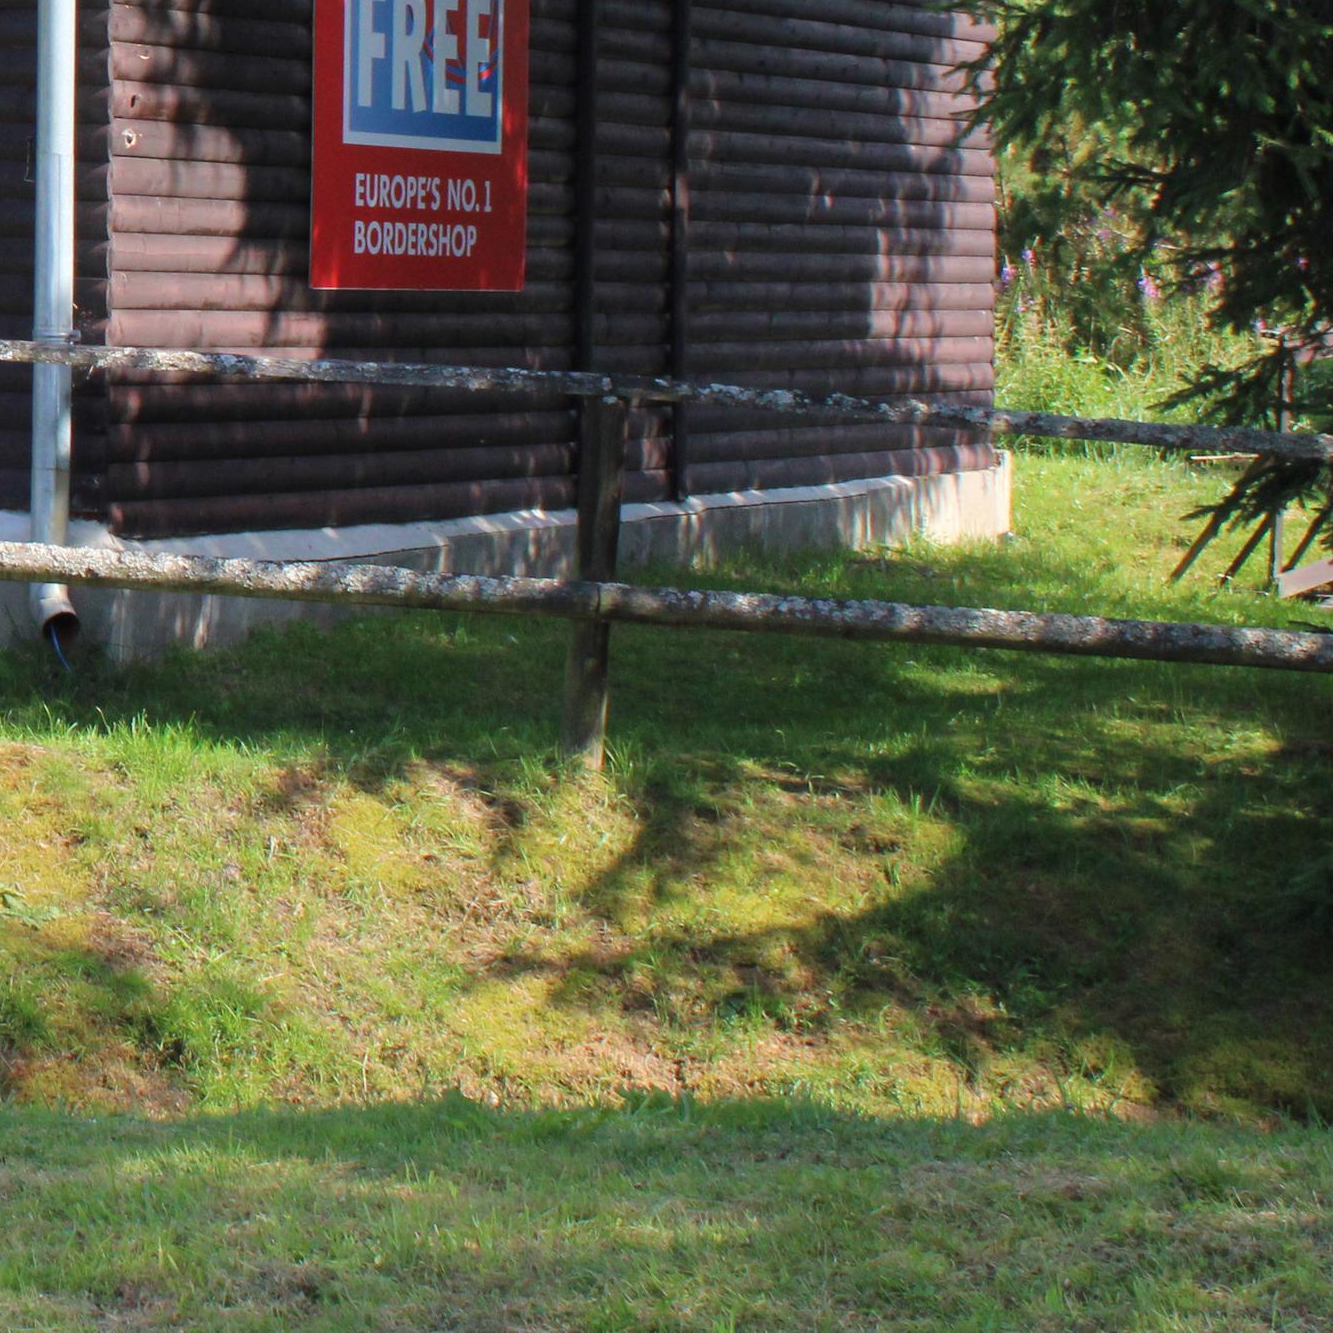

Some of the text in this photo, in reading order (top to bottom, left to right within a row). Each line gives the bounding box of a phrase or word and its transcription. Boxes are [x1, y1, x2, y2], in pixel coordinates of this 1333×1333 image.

[355, 173, 492, 212] EUROPE'S NO. 1
[354, 220, 477, 257] BORDERSHOP
